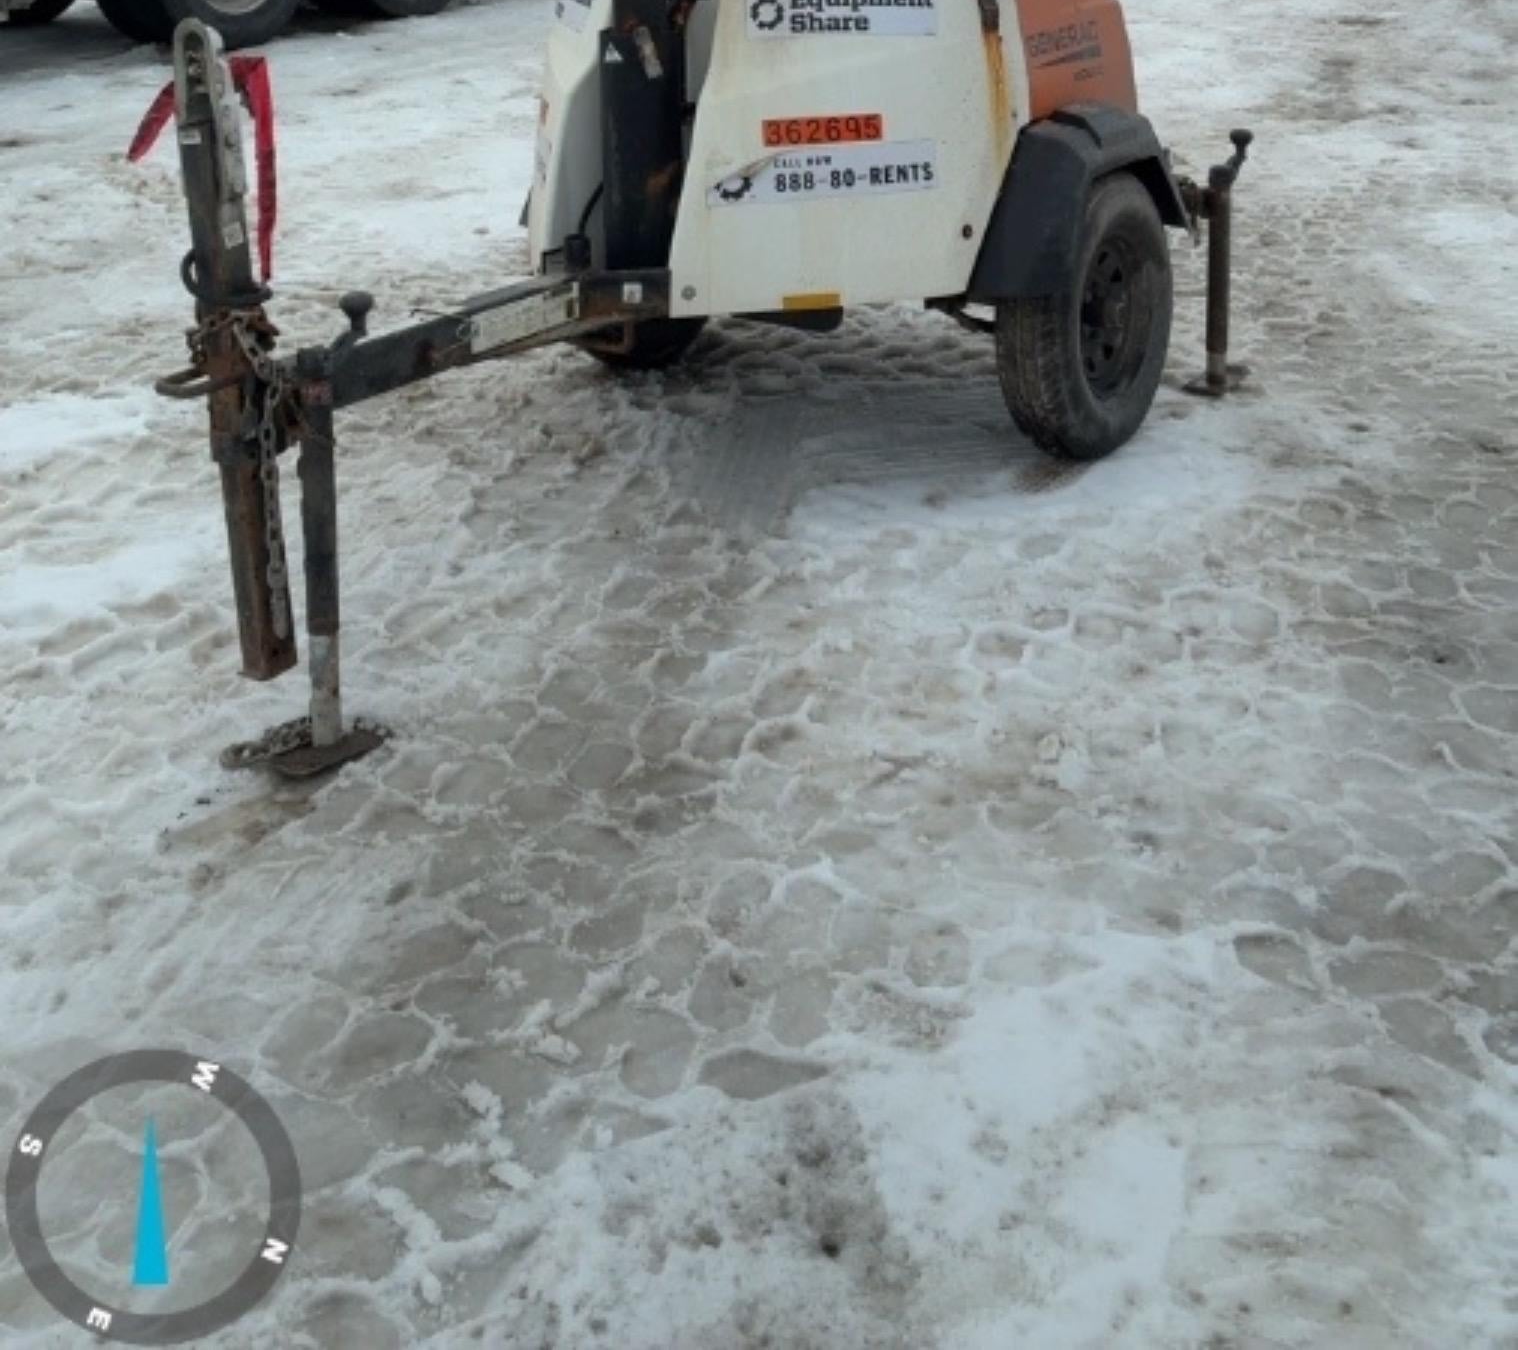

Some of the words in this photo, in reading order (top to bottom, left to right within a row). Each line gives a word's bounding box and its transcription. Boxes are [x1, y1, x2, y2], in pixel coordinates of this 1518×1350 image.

[789, 12, 870, 34] Share
[766, 115, 881, 146] 362695
[774, 161, 935, 194] 888-80-RENTS
